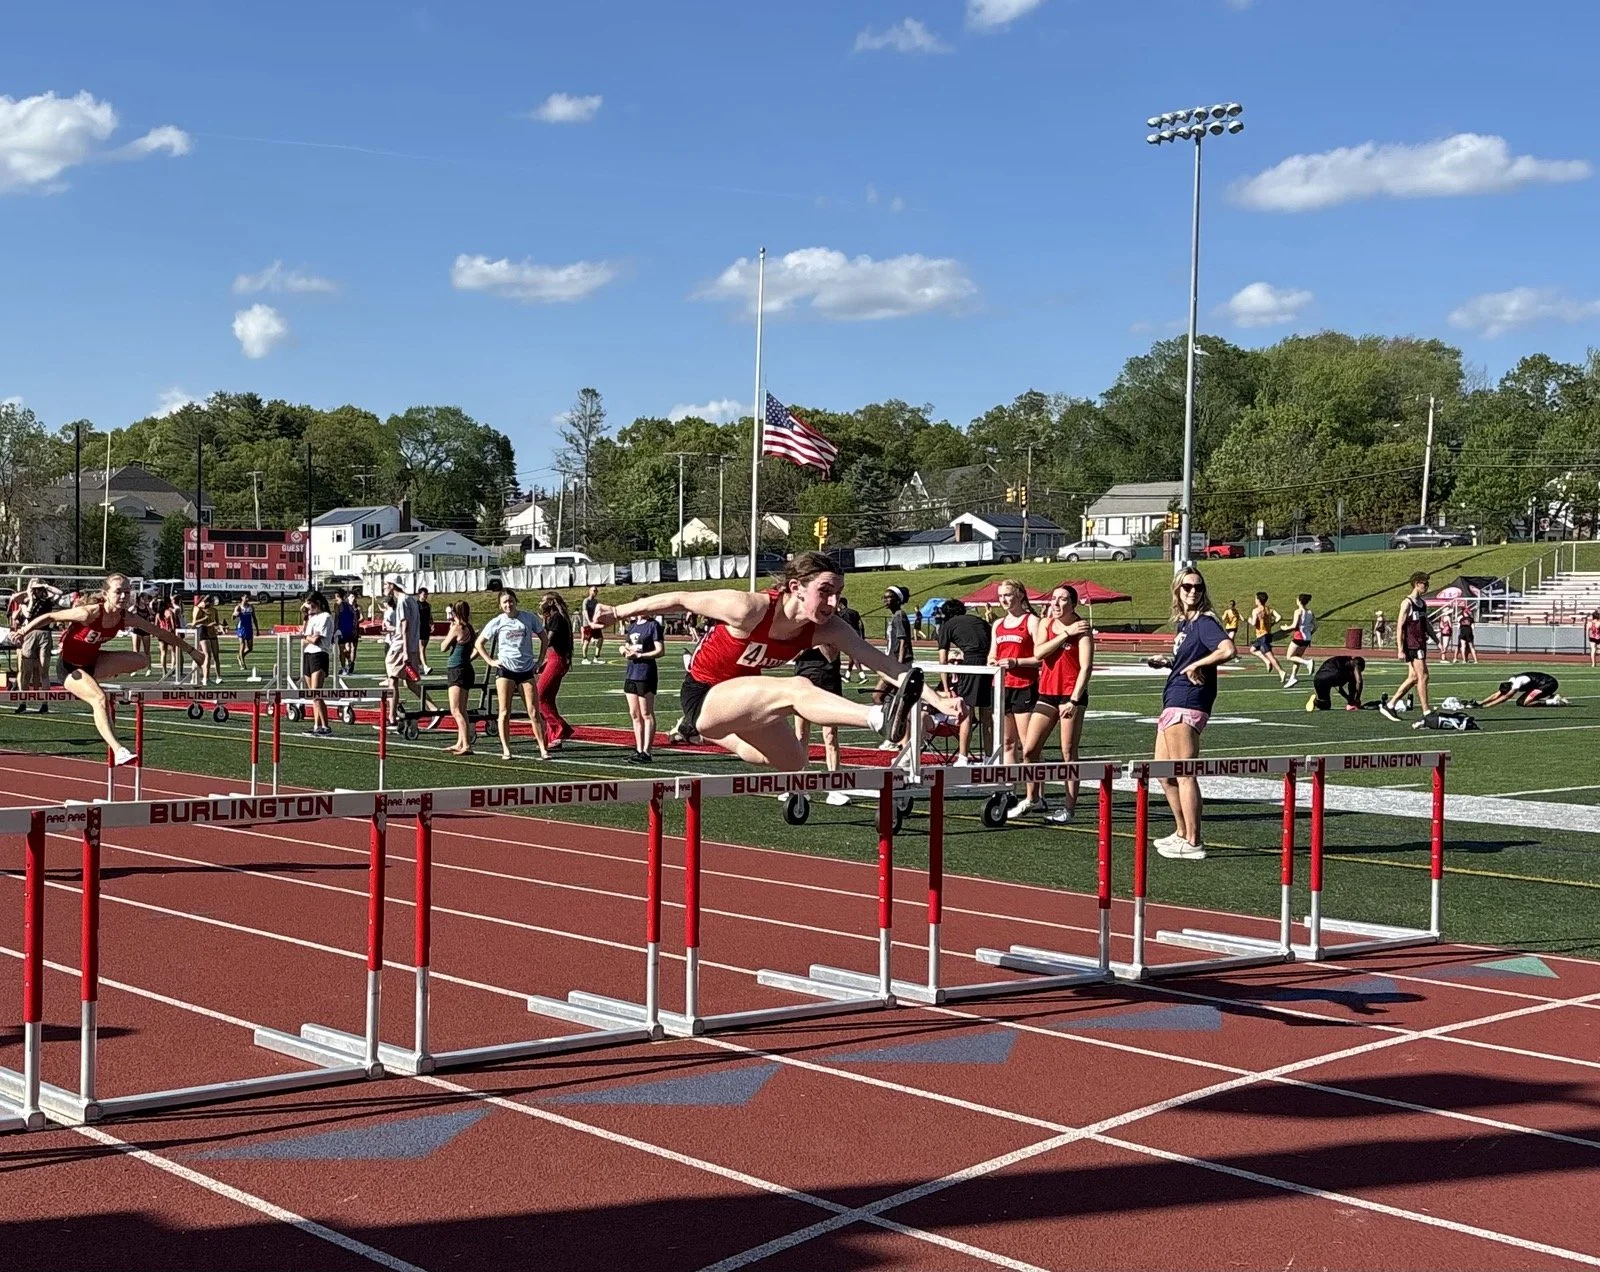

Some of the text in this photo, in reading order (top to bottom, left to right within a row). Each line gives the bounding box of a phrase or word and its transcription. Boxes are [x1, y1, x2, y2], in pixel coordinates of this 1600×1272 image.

[88, 632, 98, 642] 3
[743, 645, 763, 665] 4
[10, 692, 81, 701] BURLINGT
[162, 692, 237, 700] BURLINGTON
[298, 690, 367, 698] BURLINGTON
[1174, 759, 1268, 776] BURLINGTON
[1344, 754, 1421, 769] BURLINGTON
[971, 765, 1079, 783] BURLINGTON
[732, 773, 856, 794] BURLINGTON
[470, 783, 618, 807] BURLINGTON
[150, 796, 333, 824] BURLINGTON
